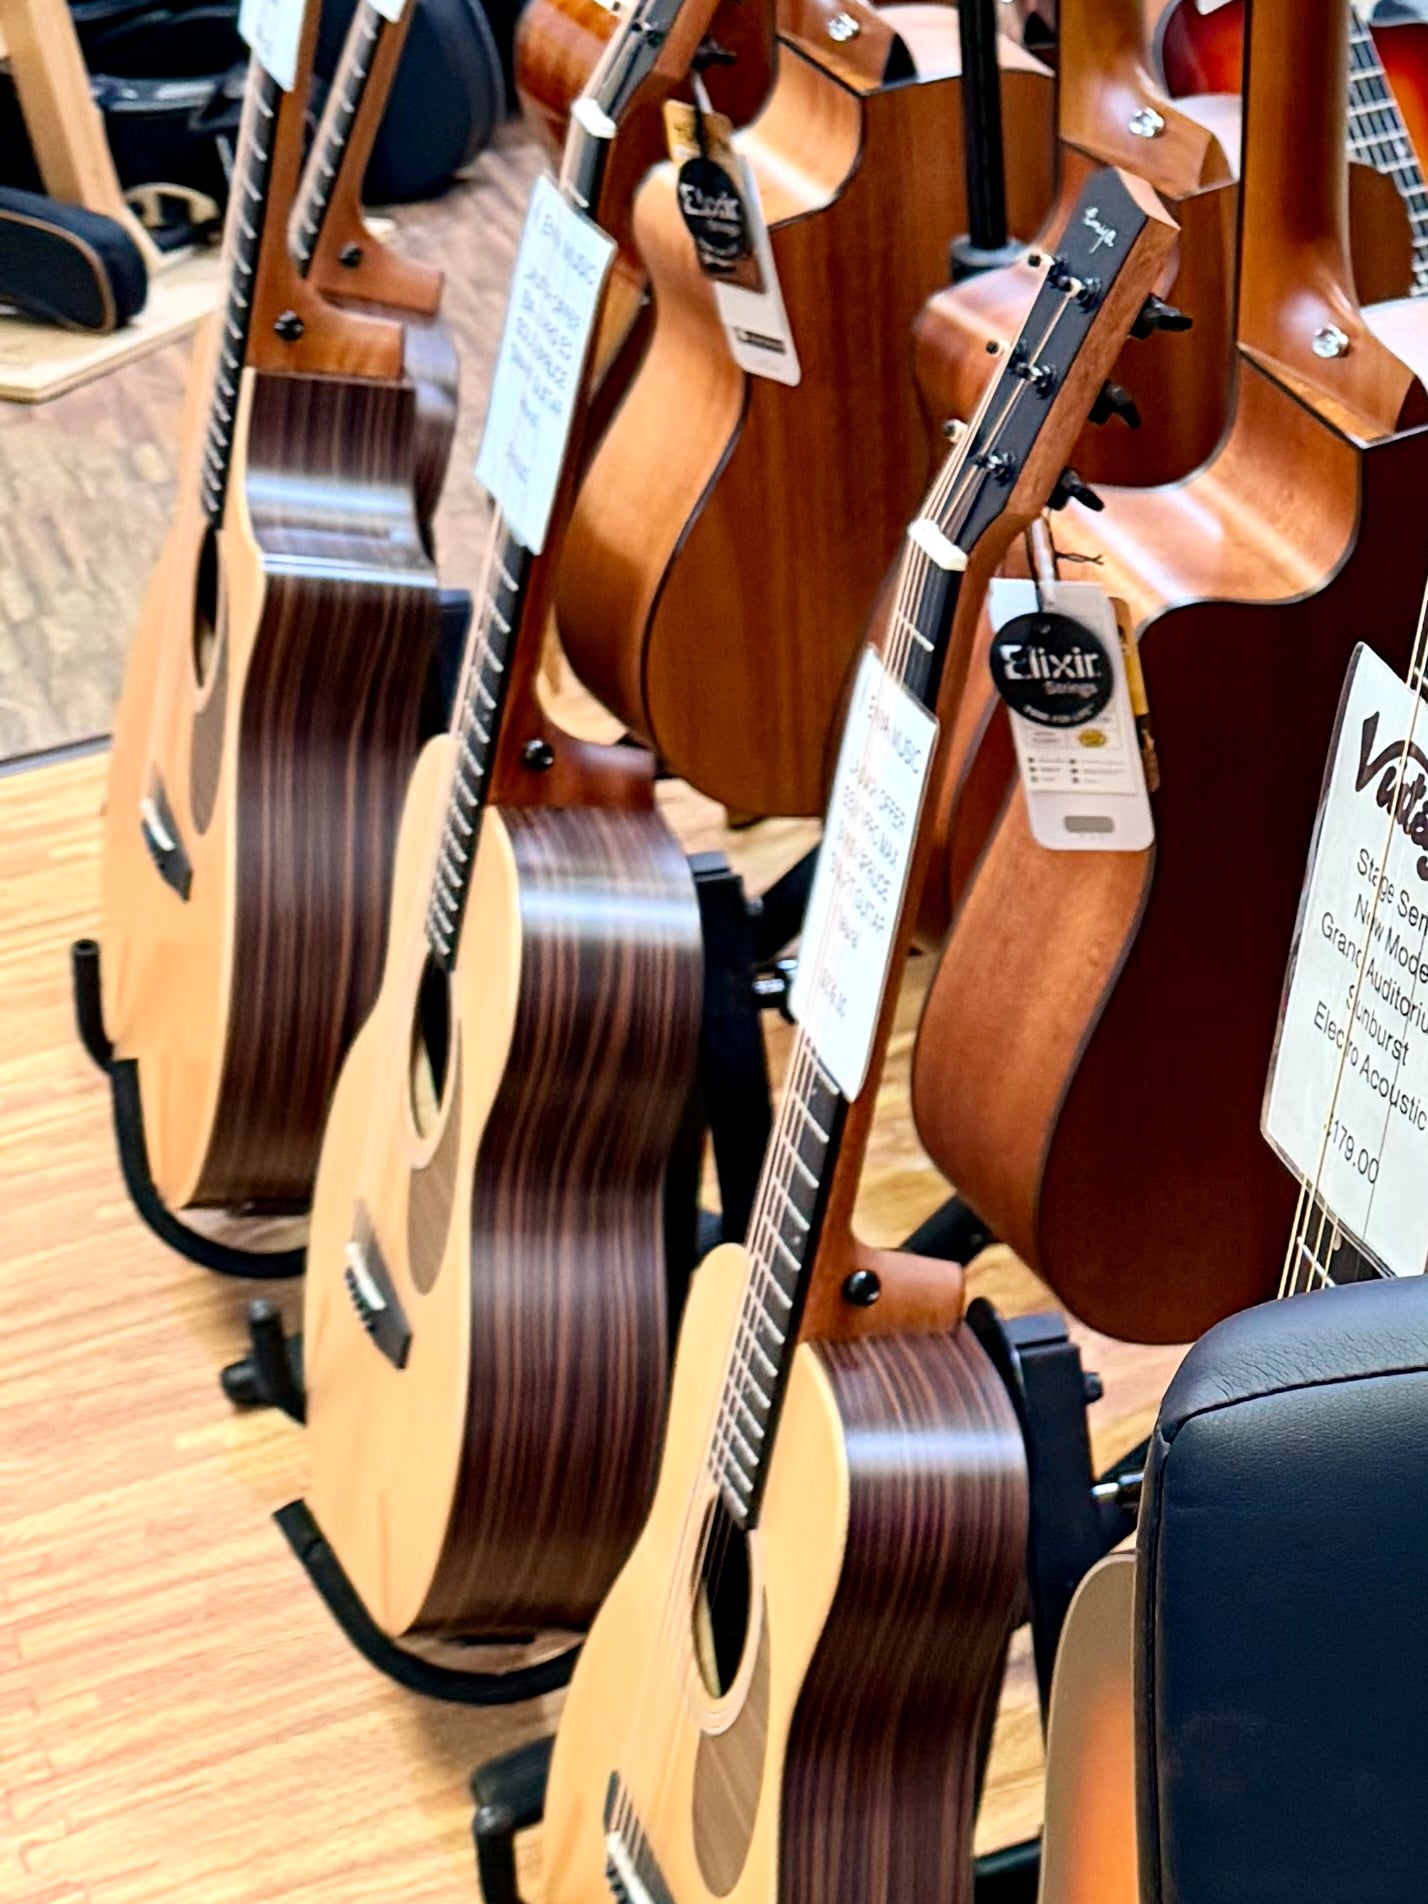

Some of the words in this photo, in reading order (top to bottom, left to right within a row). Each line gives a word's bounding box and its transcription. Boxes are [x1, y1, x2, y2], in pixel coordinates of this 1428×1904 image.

[1000, 643, 1101, 681] Elixir
[1356, 847, 1395, 905] Stage
[1345, 983, 1411, 1067] Sunburst
[1313, 998, 1360, 1066] Elecro
[1358, 1053, 1428, 1132] Acoustic
[1322, 1111, 1381, 1186] 179.00
